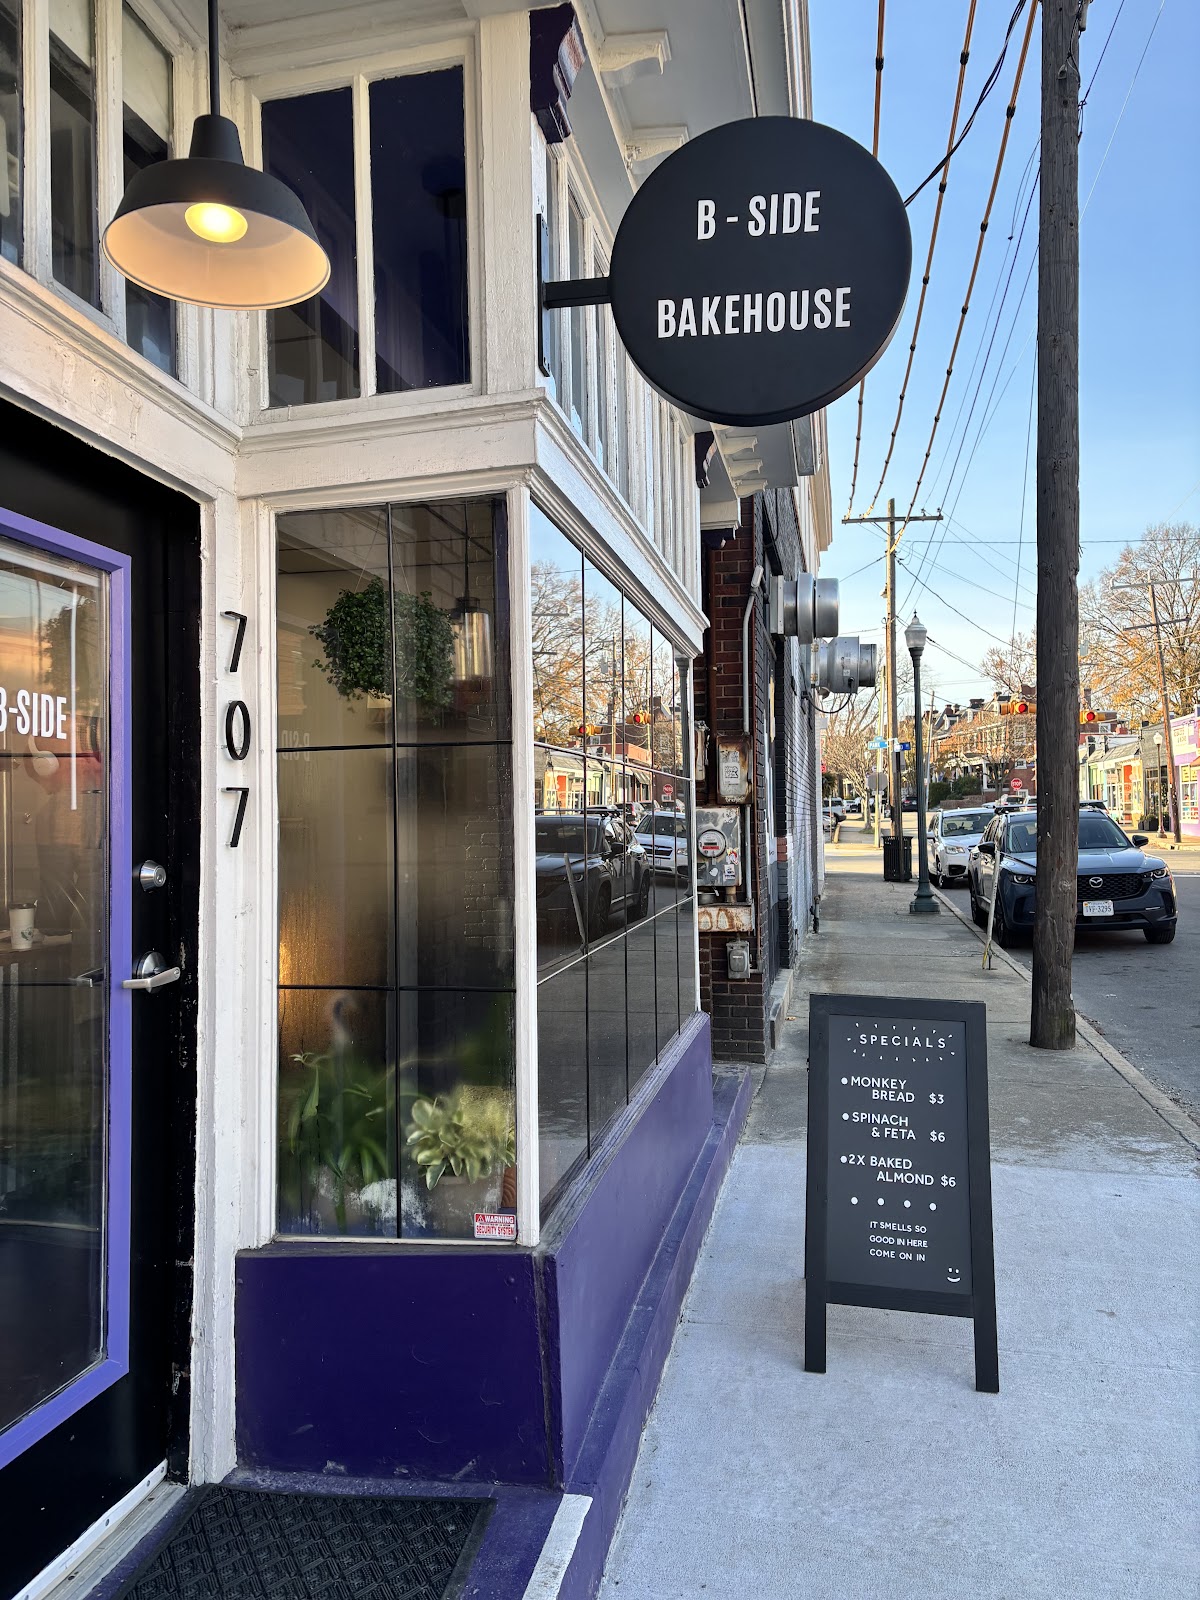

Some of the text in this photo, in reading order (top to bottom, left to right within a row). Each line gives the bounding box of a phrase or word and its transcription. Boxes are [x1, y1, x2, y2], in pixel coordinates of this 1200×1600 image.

[697, 199, 716, 240] B
[747, 190, 821, 238] SIDE
[657, 286, 851, 339] BAKEHOUSE
[220, 610, 251, 848] 707
[859, 1033, 946, 1049] SPECIALS
[850, 1076, 907, 1090] MONKEY
[871, 1088, 945, 1105] BREAD $3
[851, 1112, 909, 1127] SPINACH
[871, 1126, 946, 1143] & FETA $6
[848, 1154, 913, 1170] 2X BAKED
[876, 1171, 957, 1188] ALMOND $6
[484, 1215, 513, 1223] WARNING
[869, 1220, 927, 1233] IT SMELLS SO
[476, 1225, 515, 1235] SECURITY SYSTEM
[869, 1234, 929, 1248] GOOD IN HERE
[869, 1248, 926, 1262] COME ON IN
